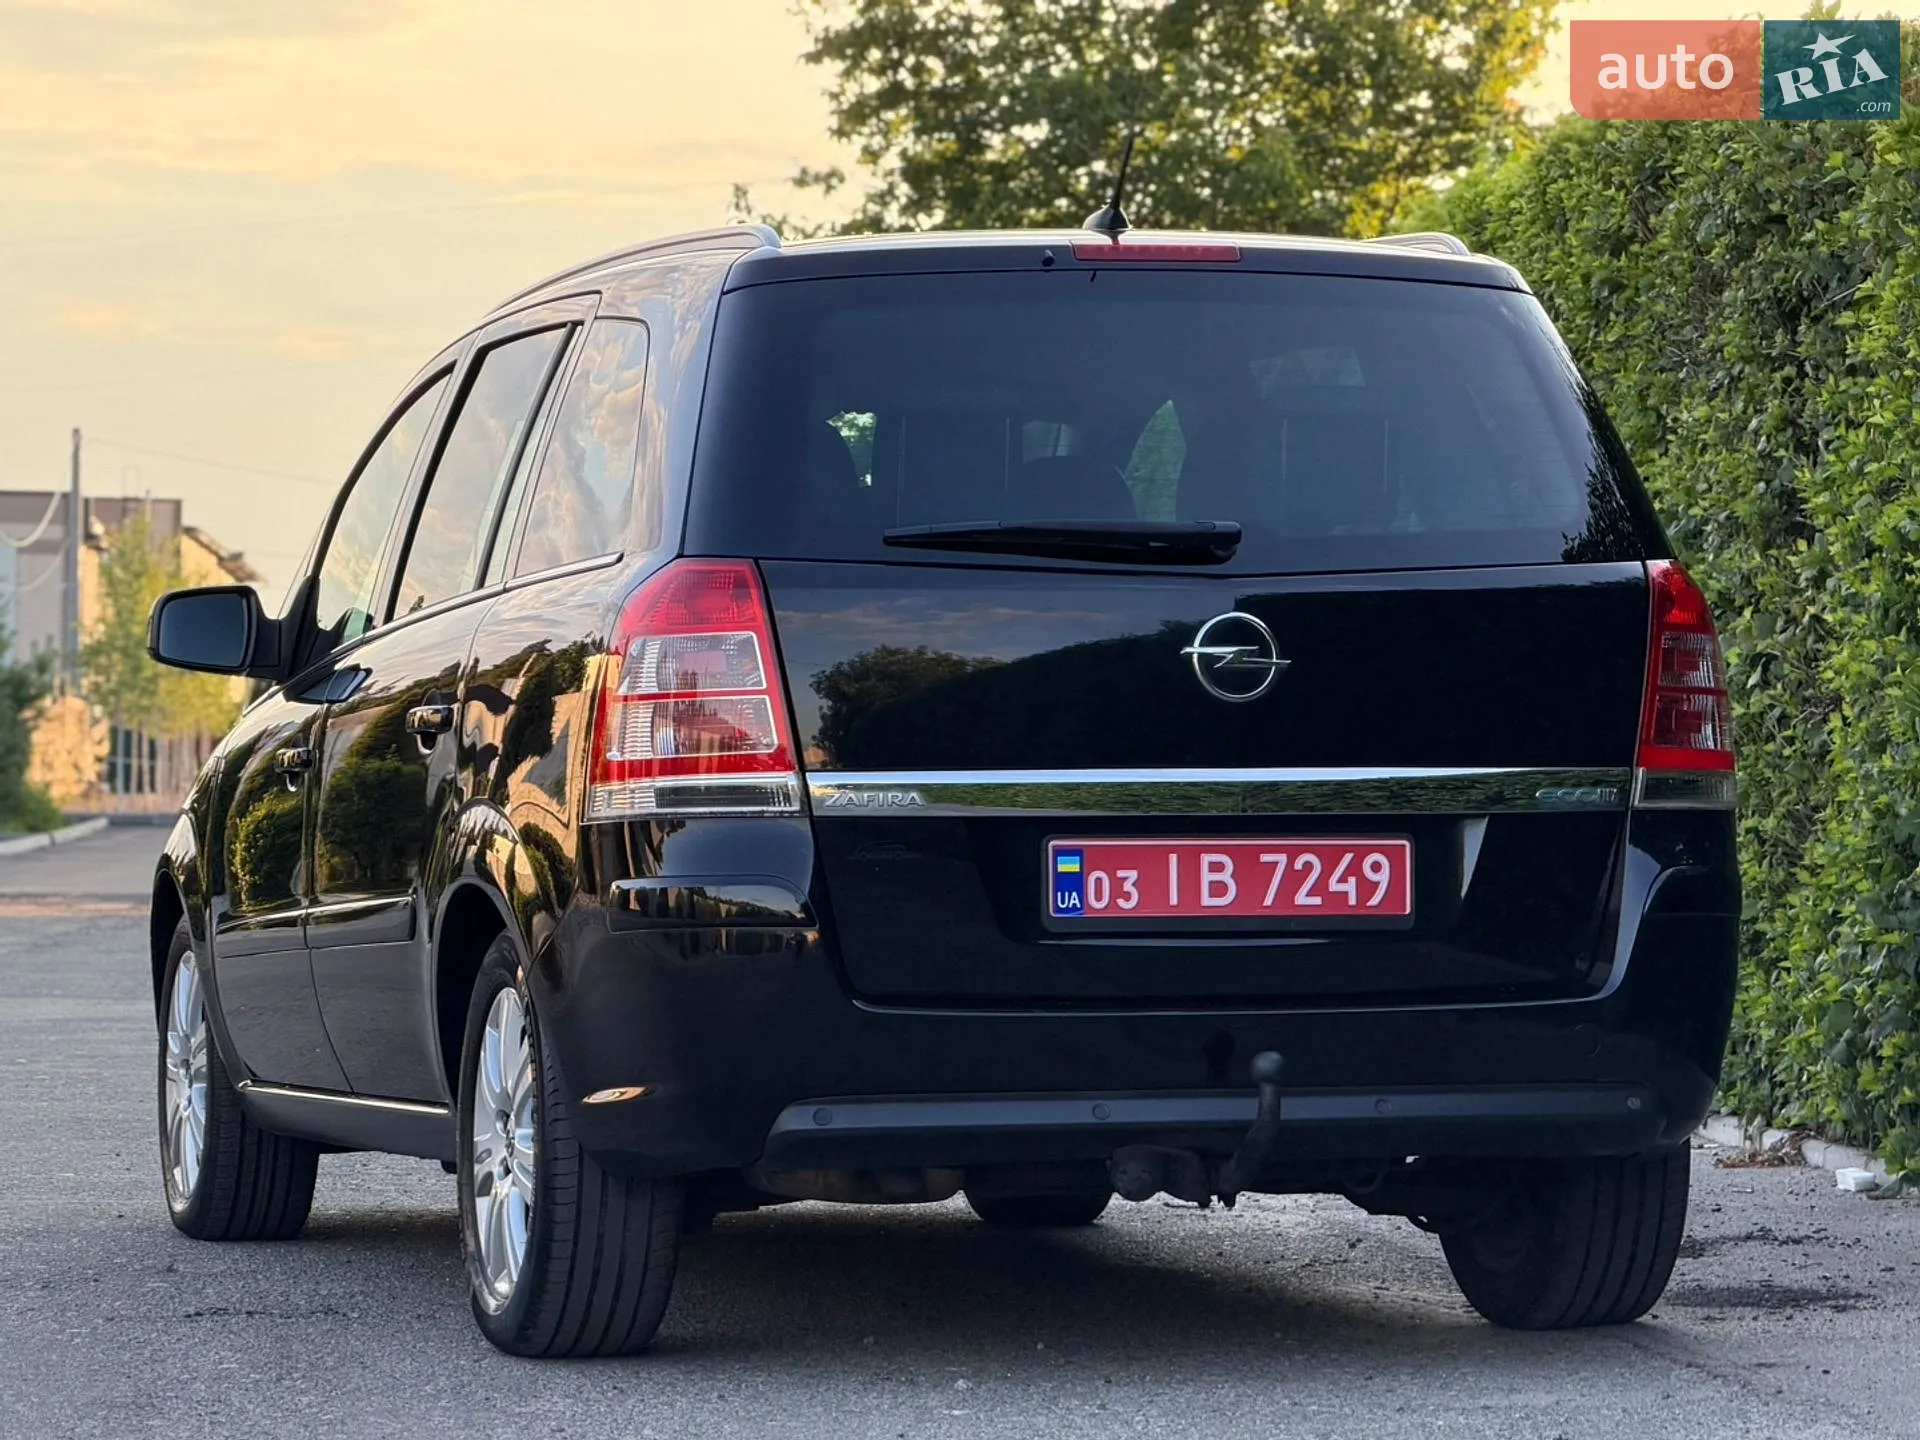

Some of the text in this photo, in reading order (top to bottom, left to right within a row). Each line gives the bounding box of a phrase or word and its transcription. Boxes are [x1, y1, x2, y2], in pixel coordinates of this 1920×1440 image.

[825, 790, 926, 807] ZAFIRA
[1087, 870, 1140, 909] 03
[1260, 853, 1391, 906] 7249
[1057, 891, 1081, 908] UA
